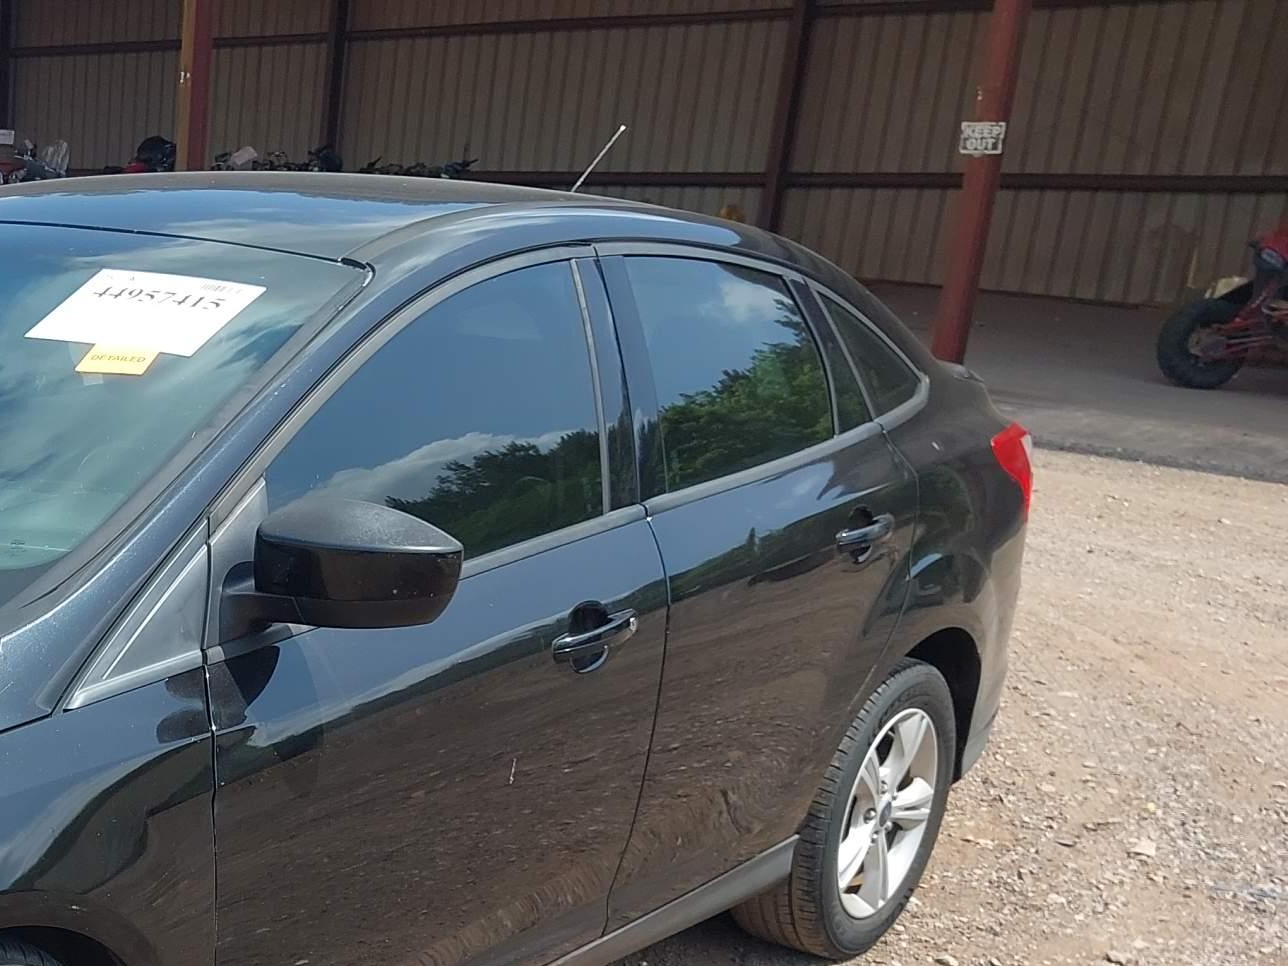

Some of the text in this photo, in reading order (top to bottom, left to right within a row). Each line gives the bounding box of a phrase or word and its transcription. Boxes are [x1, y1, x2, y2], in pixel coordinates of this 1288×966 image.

[964, 126, 1001, 138] KEEP
[966, 138, 996, 150] OUT
[93, 286, 227, 310] 44957415
